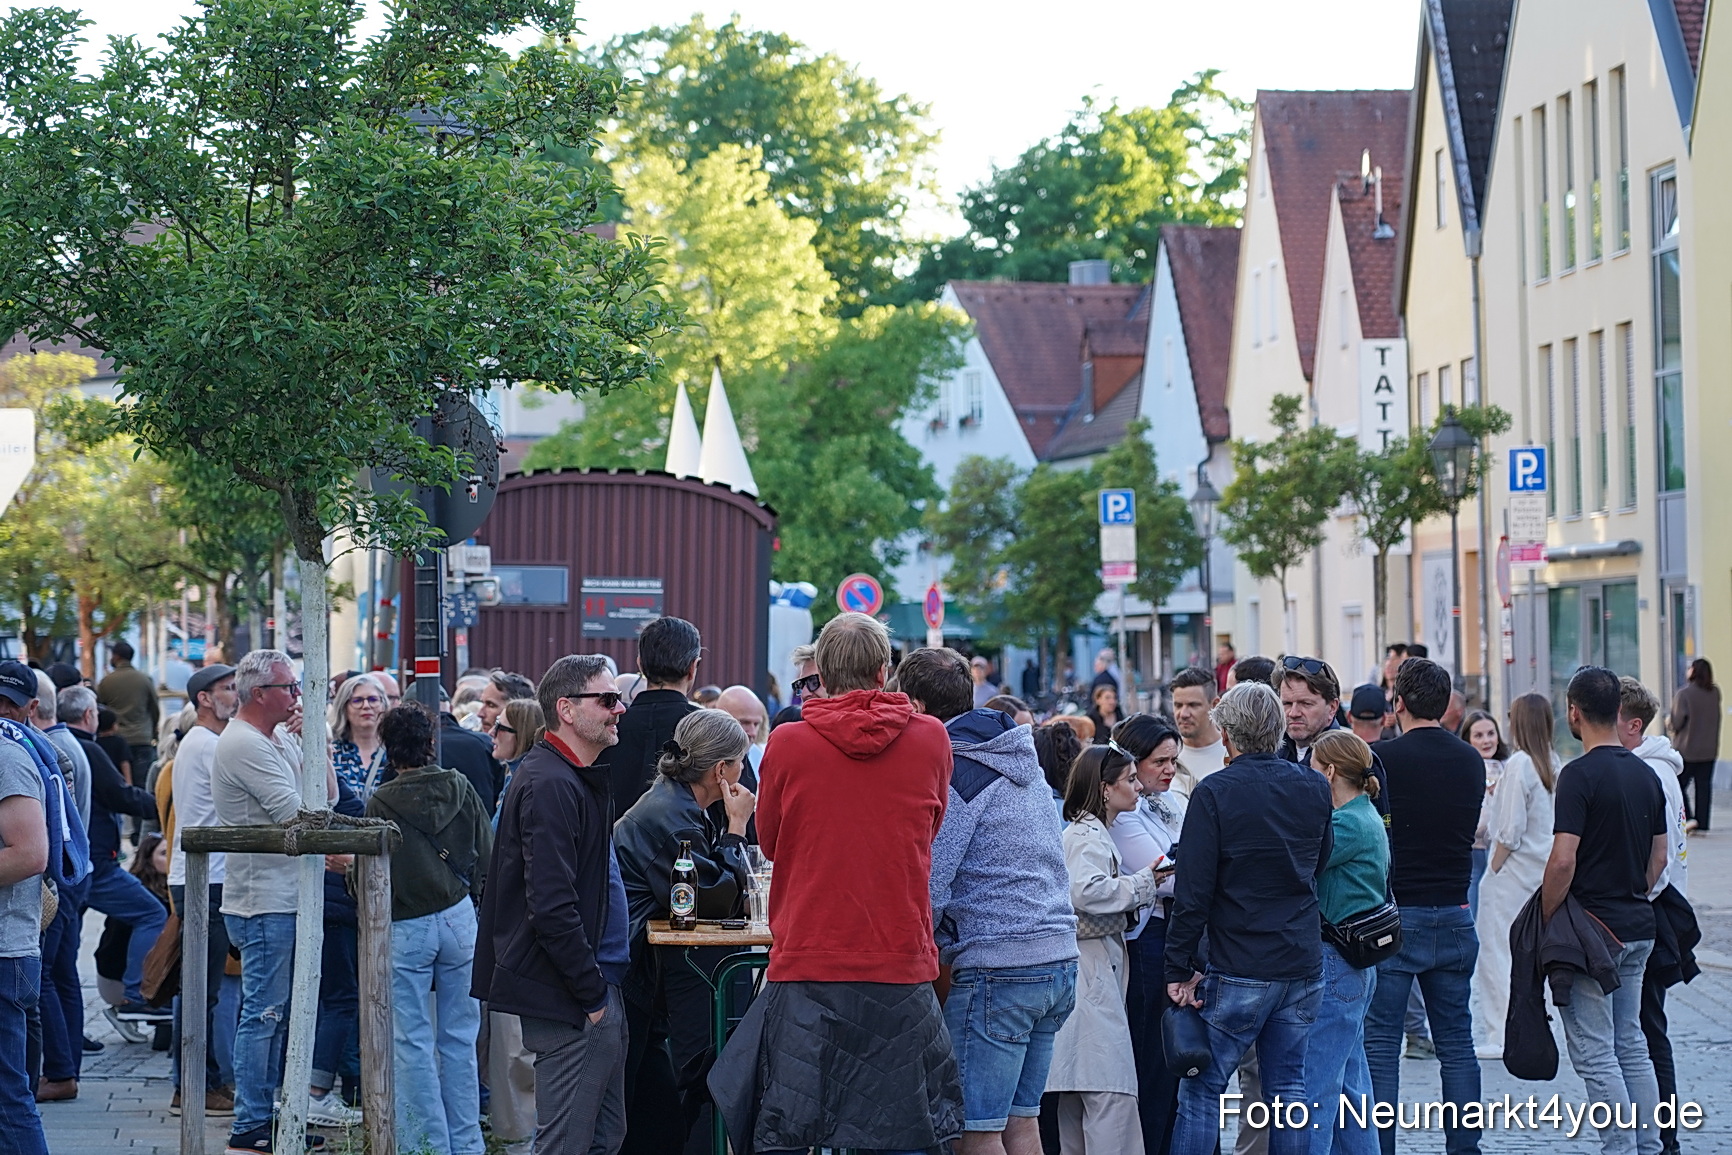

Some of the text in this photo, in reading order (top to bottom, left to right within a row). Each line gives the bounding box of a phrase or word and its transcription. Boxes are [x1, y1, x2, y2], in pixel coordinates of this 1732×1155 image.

[1374, 346, 1393, 450] TATT
[1516, 451, 1538, 488] P
[1107, 494, 1127, 521] P
